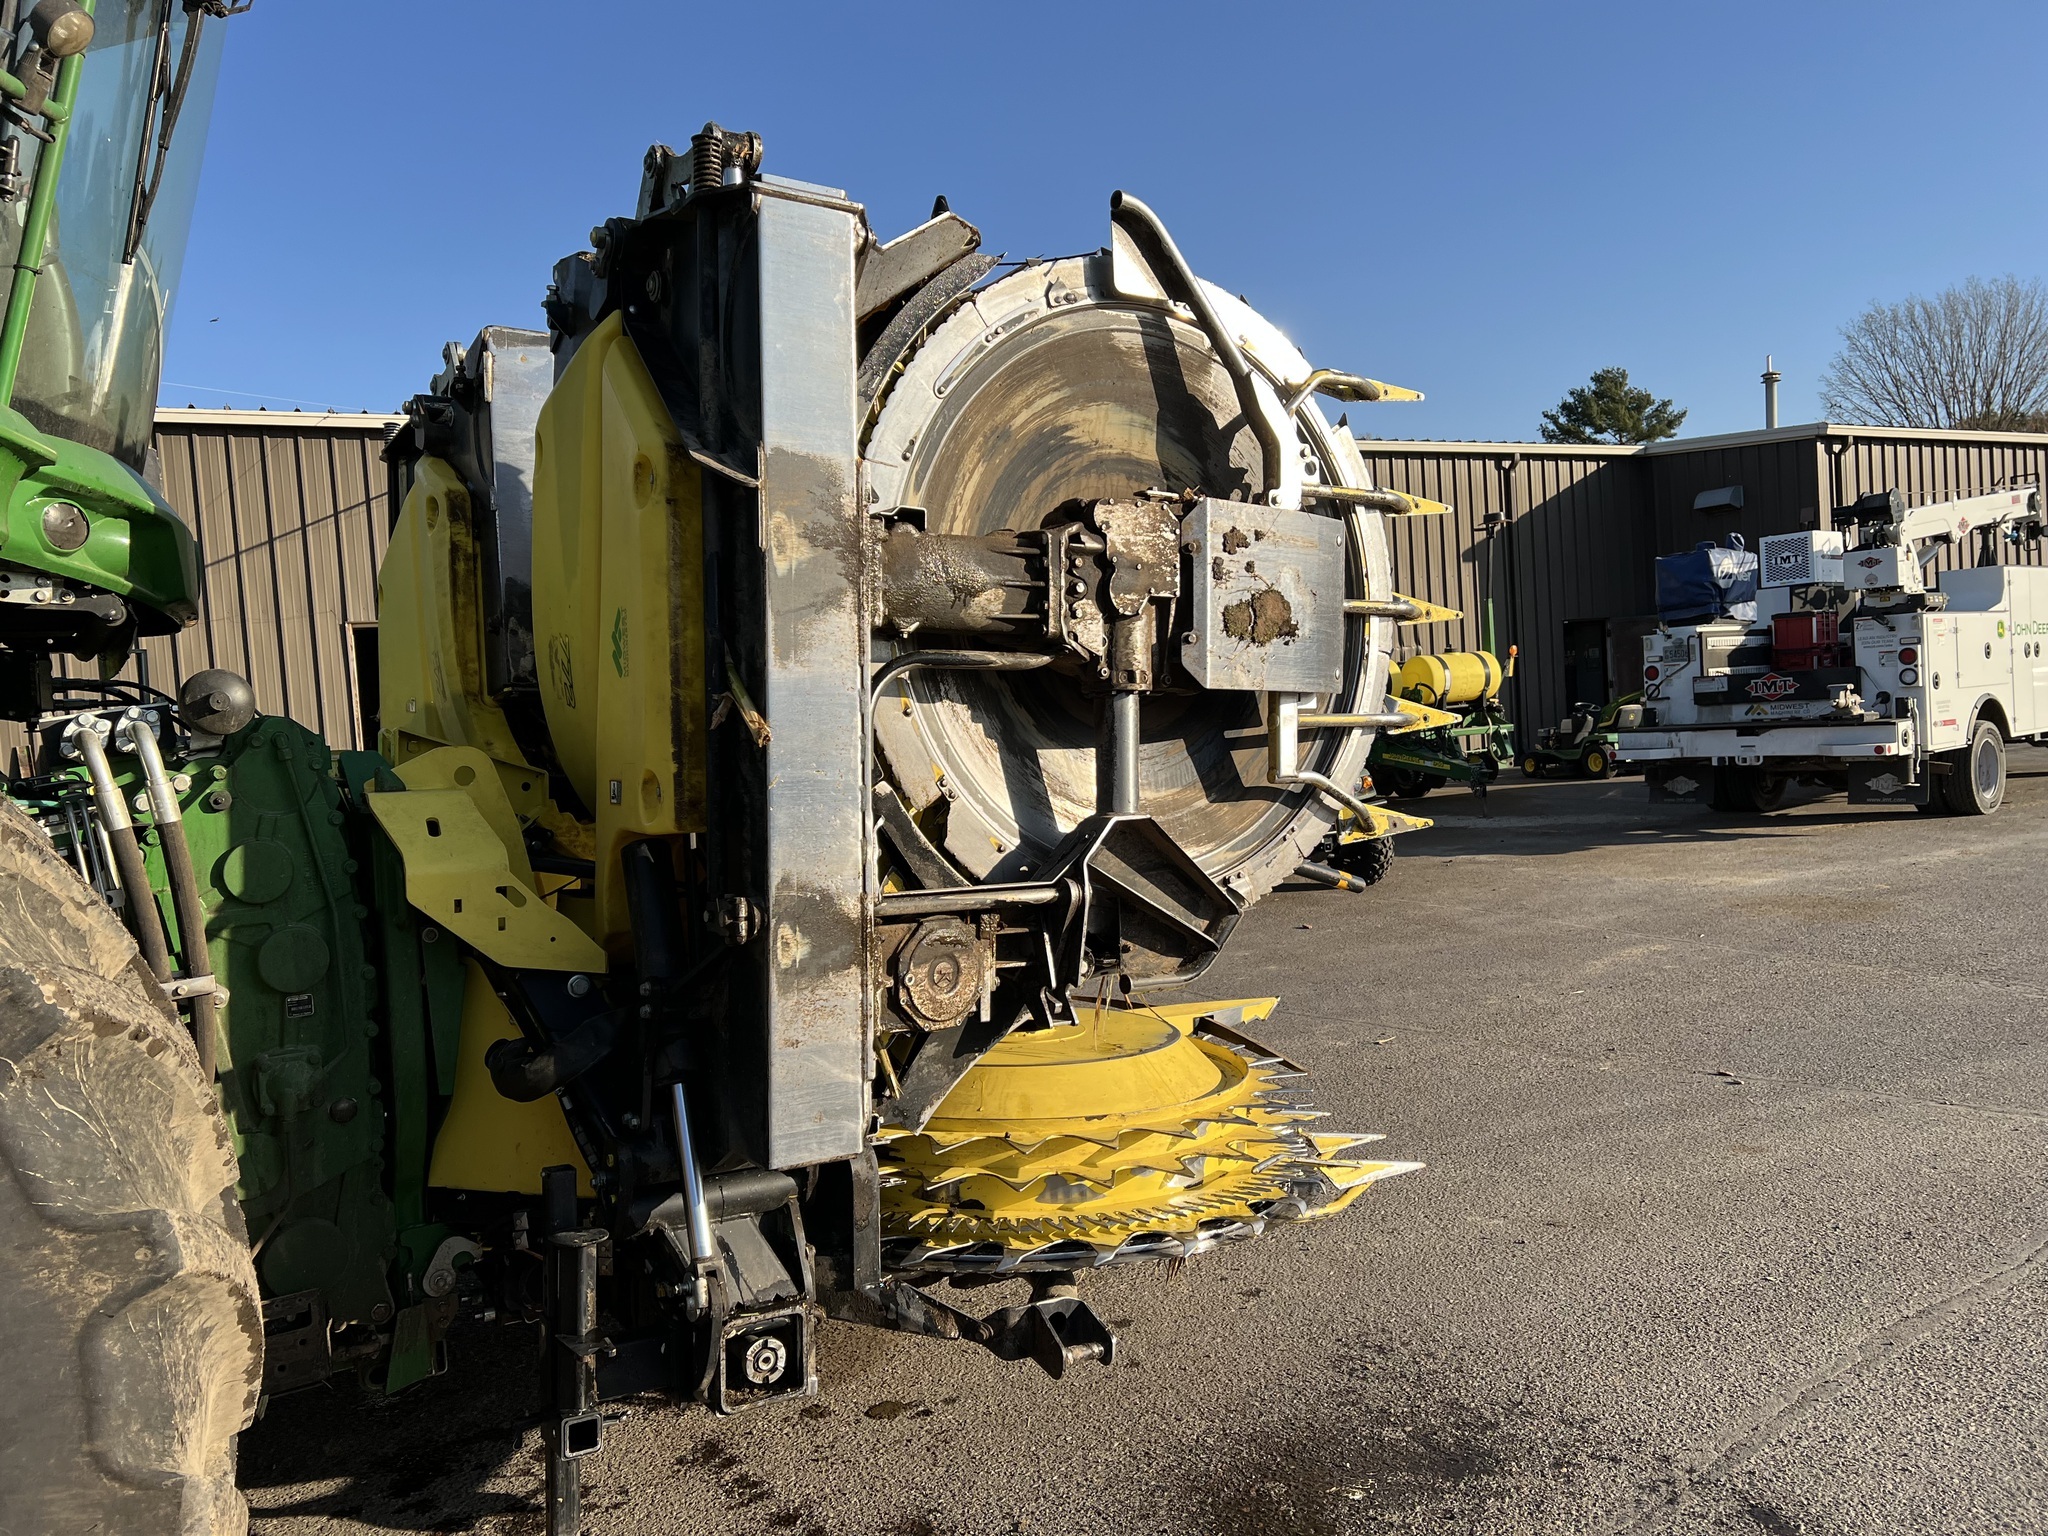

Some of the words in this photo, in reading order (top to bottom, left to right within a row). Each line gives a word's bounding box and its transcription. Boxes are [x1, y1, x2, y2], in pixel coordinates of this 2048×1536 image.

[1773, 554, 1800, 565] IMT
[2012, 621, 2031, 636] JOHN
[1752, 679, 1793, 695] IMT
[1770, 702, 1810, 711] MIDWEST
